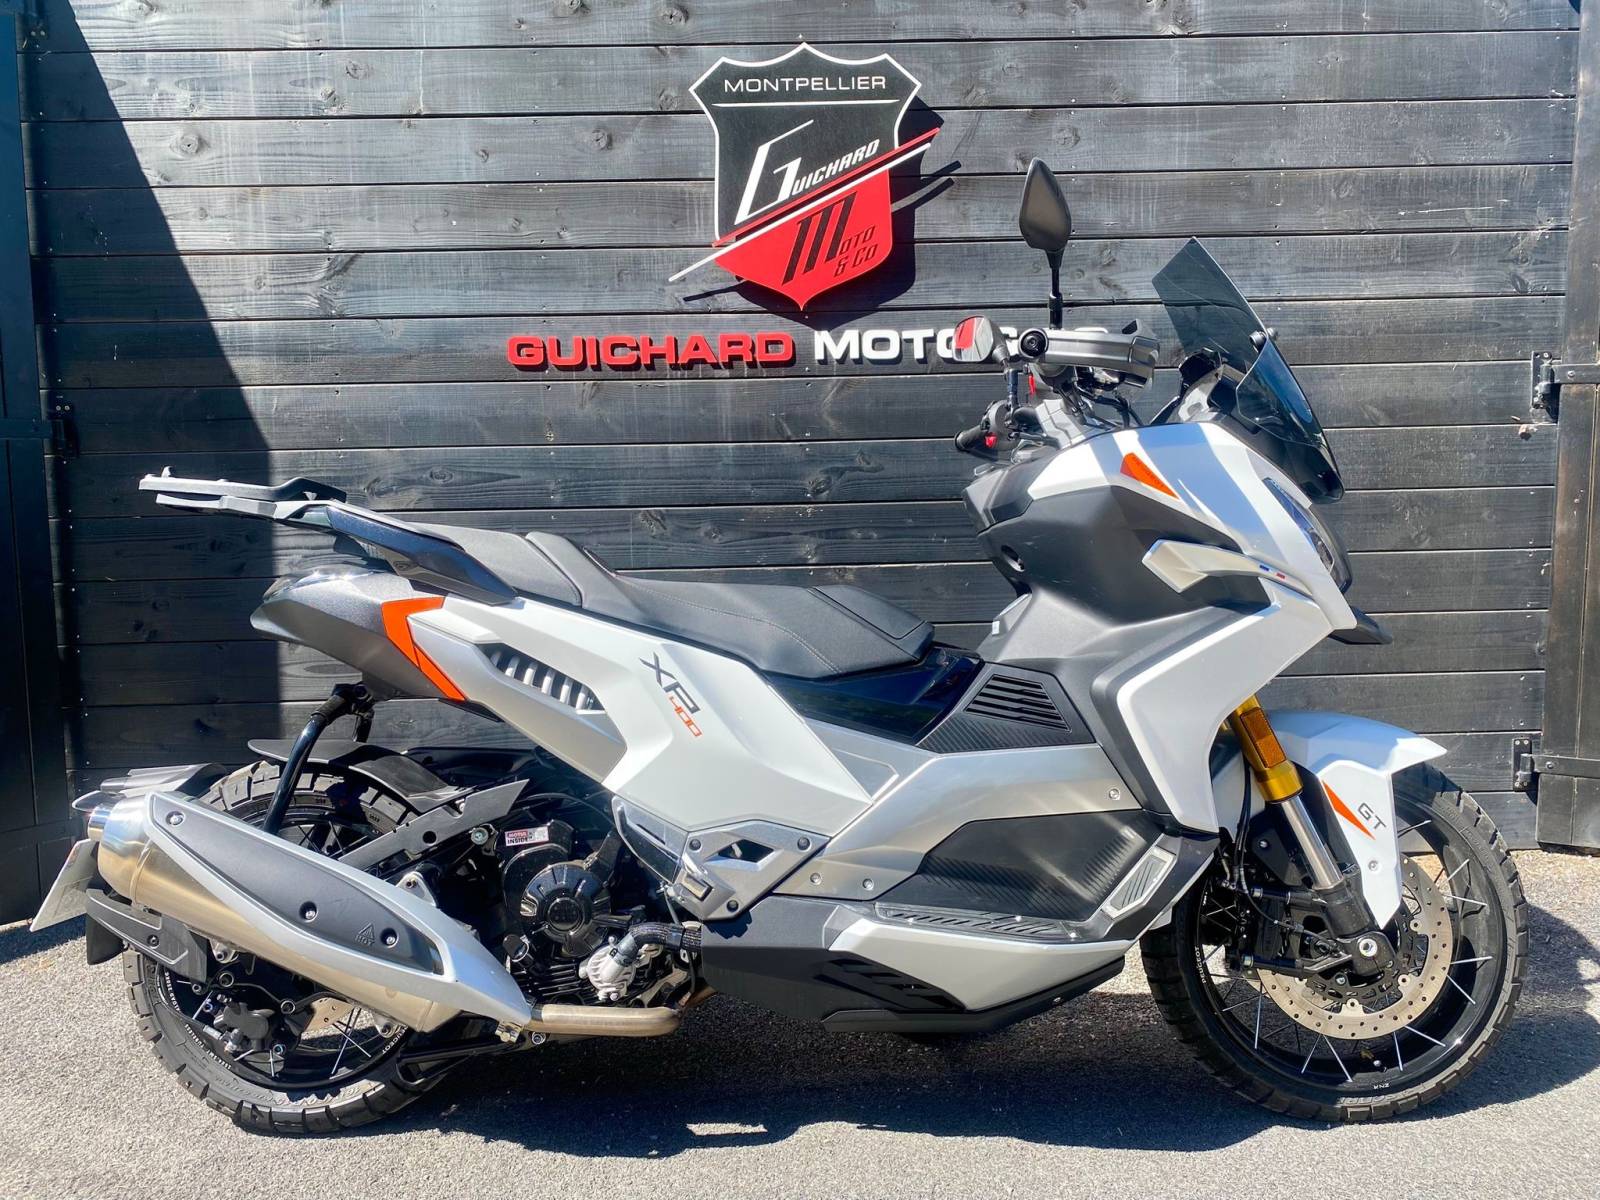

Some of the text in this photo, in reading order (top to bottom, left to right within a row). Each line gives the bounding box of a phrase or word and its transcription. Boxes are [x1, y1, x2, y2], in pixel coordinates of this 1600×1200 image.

[724, 76, 886, 93] MONTPELLIER
[734, 119, 880, 225] GUICHARD
[782, 190, 876, 286] MOTO
[852, 243, 878, 268] CO
[507, 332, 794, 366] GUICHARD
[639, 651, 700, 714] XP
[1358, 802, 1387, 829] GT
